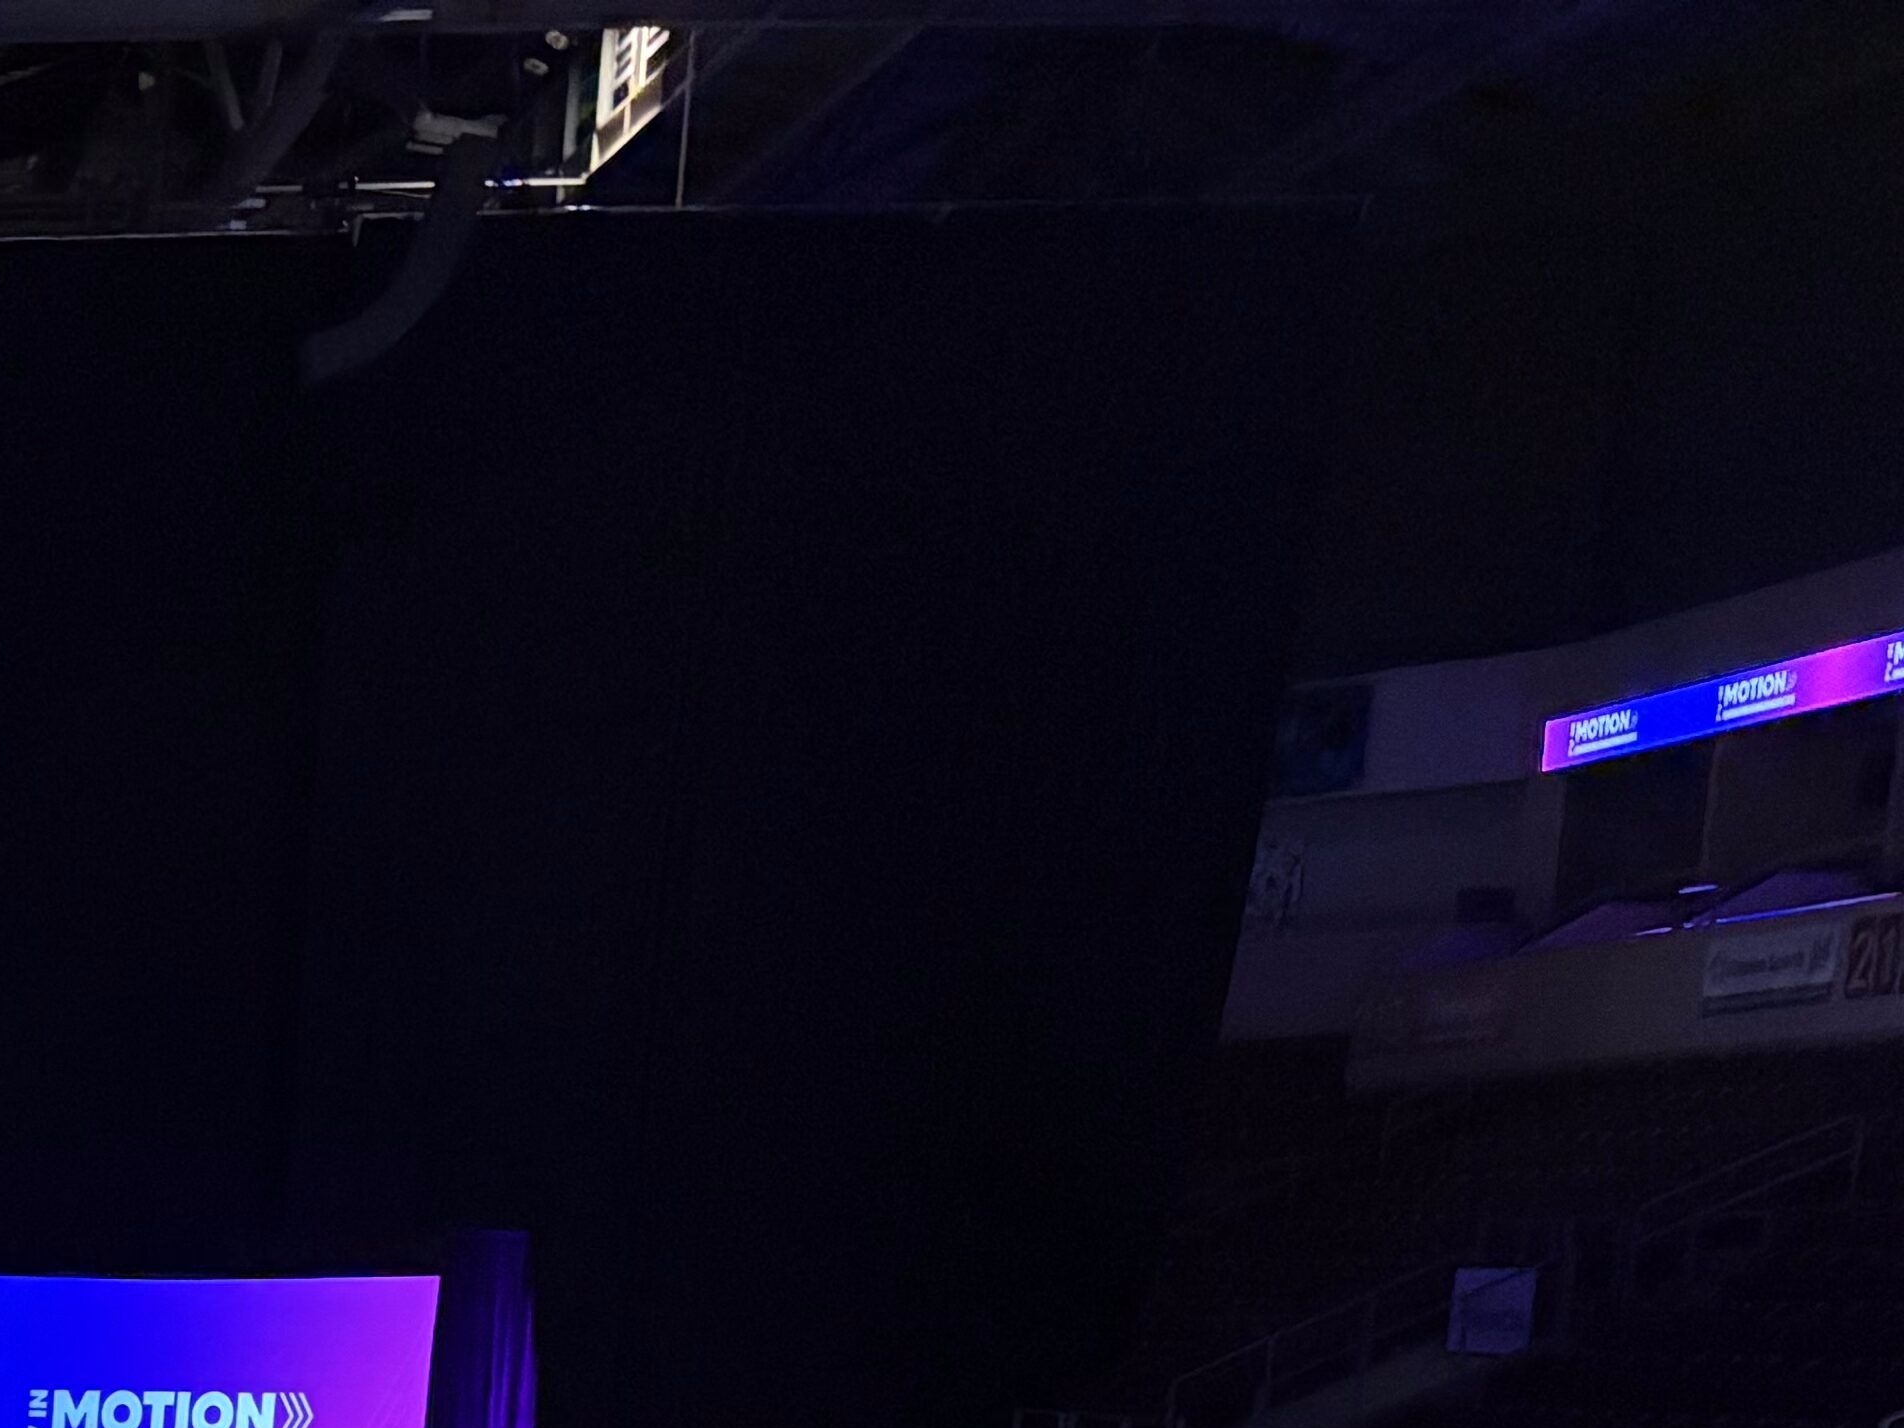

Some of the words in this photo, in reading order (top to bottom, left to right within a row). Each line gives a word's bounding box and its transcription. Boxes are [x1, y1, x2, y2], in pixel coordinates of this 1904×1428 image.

[1723, 669, 1789, 707] MOTION
[1574, 709, 1632, 743] MOTION
[28, 1389, 49, 1418] IN
